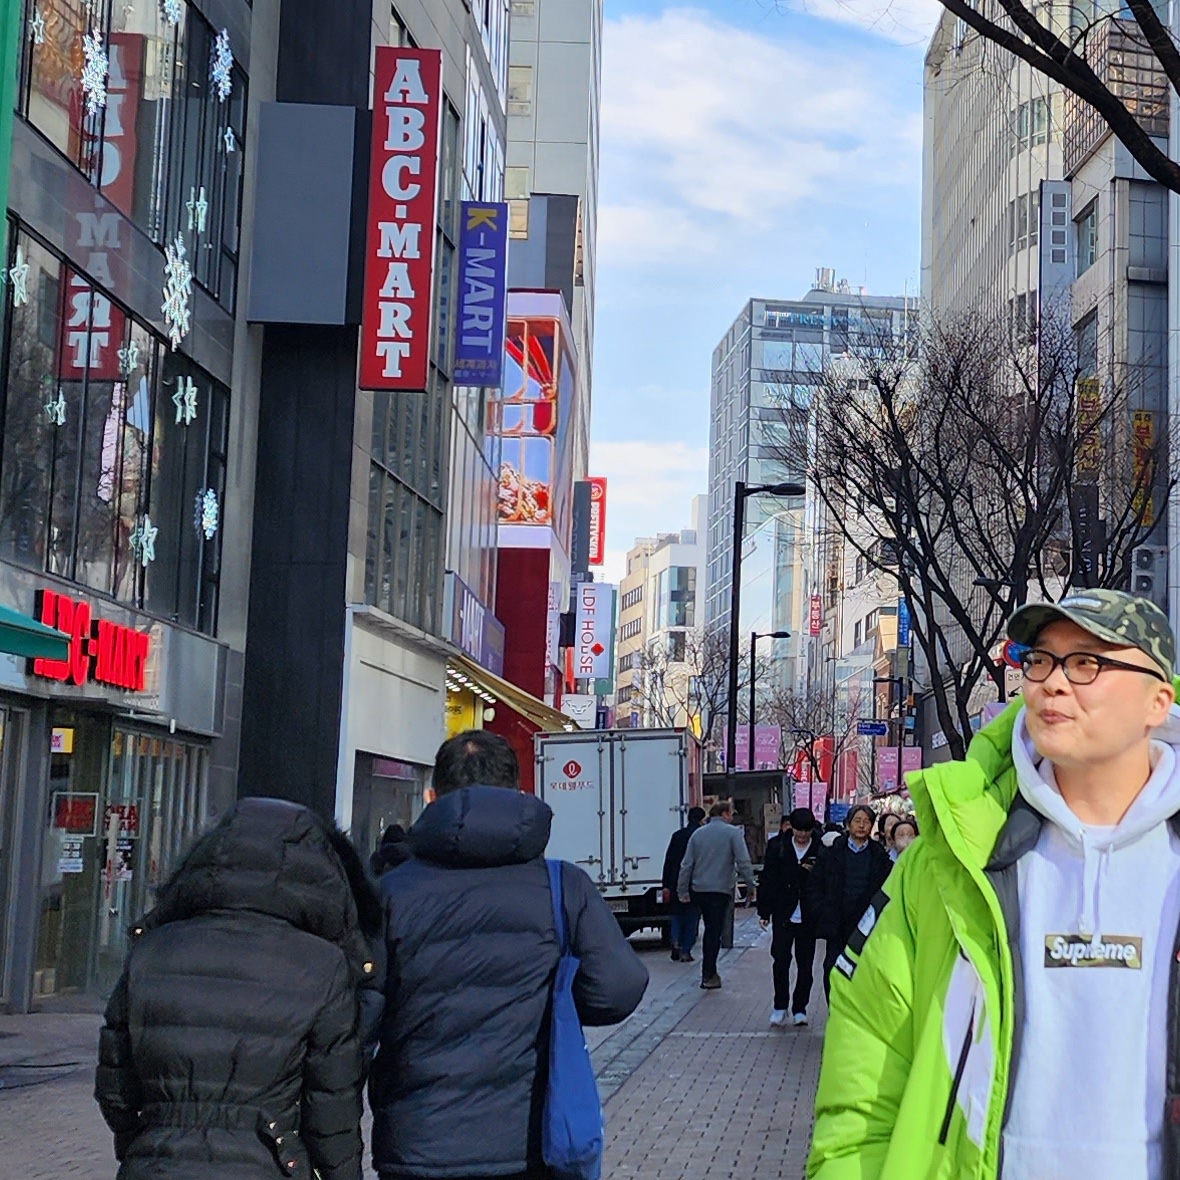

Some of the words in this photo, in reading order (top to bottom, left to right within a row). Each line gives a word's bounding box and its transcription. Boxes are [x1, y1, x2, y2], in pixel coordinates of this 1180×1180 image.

[462, 207, 498, 354] K-MART
[582, 588, 596, 616] LDF
[811, 600, 821, 629] 부동산
